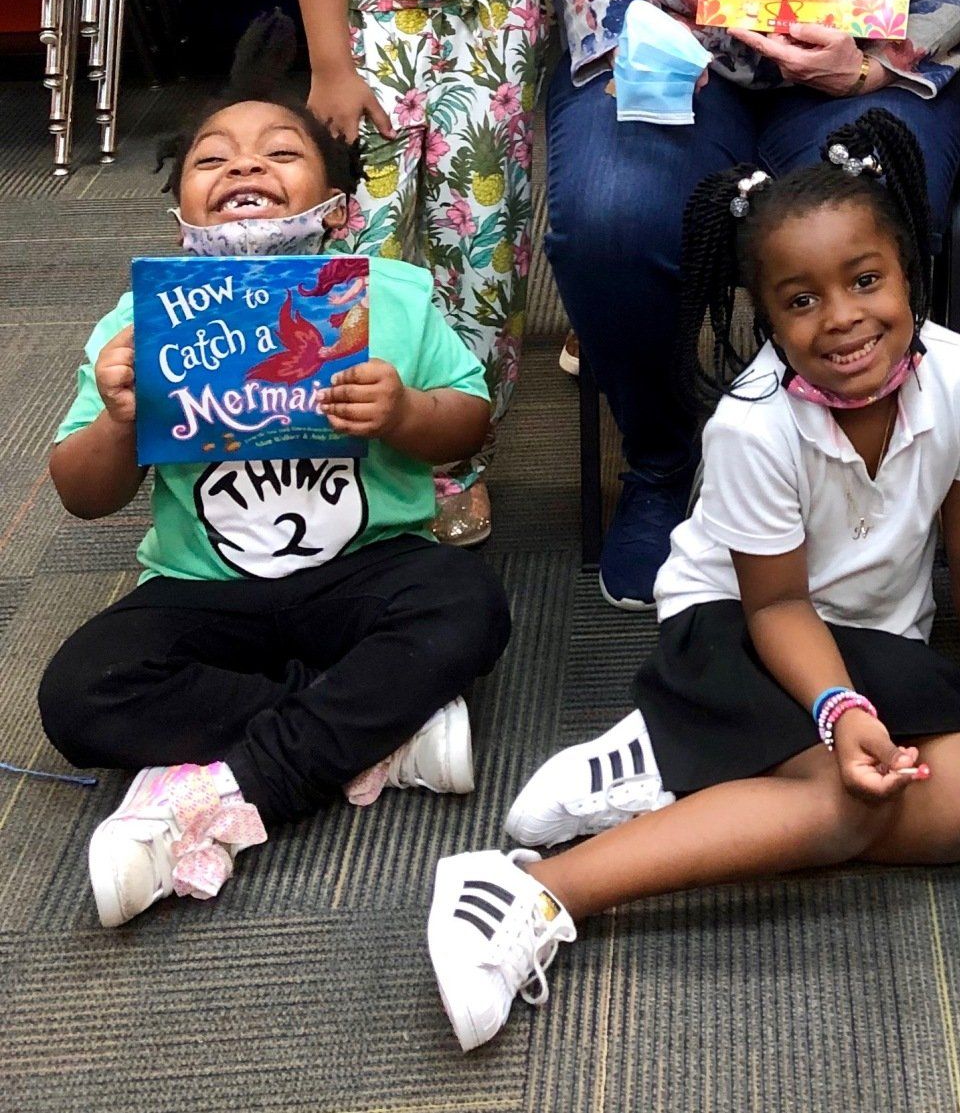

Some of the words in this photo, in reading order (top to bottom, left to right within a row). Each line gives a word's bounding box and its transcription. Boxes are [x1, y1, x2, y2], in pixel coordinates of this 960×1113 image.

[156, 274, 235, 329] How
[242, 287, 271, 310] to
[158, 319, 247, 384] Catch
[257, 323, 278, 353] a
[168, 379, 326, 440] Mermai
[208, 458, 350, 511] THING
[272, 512, 325, 558] 2
